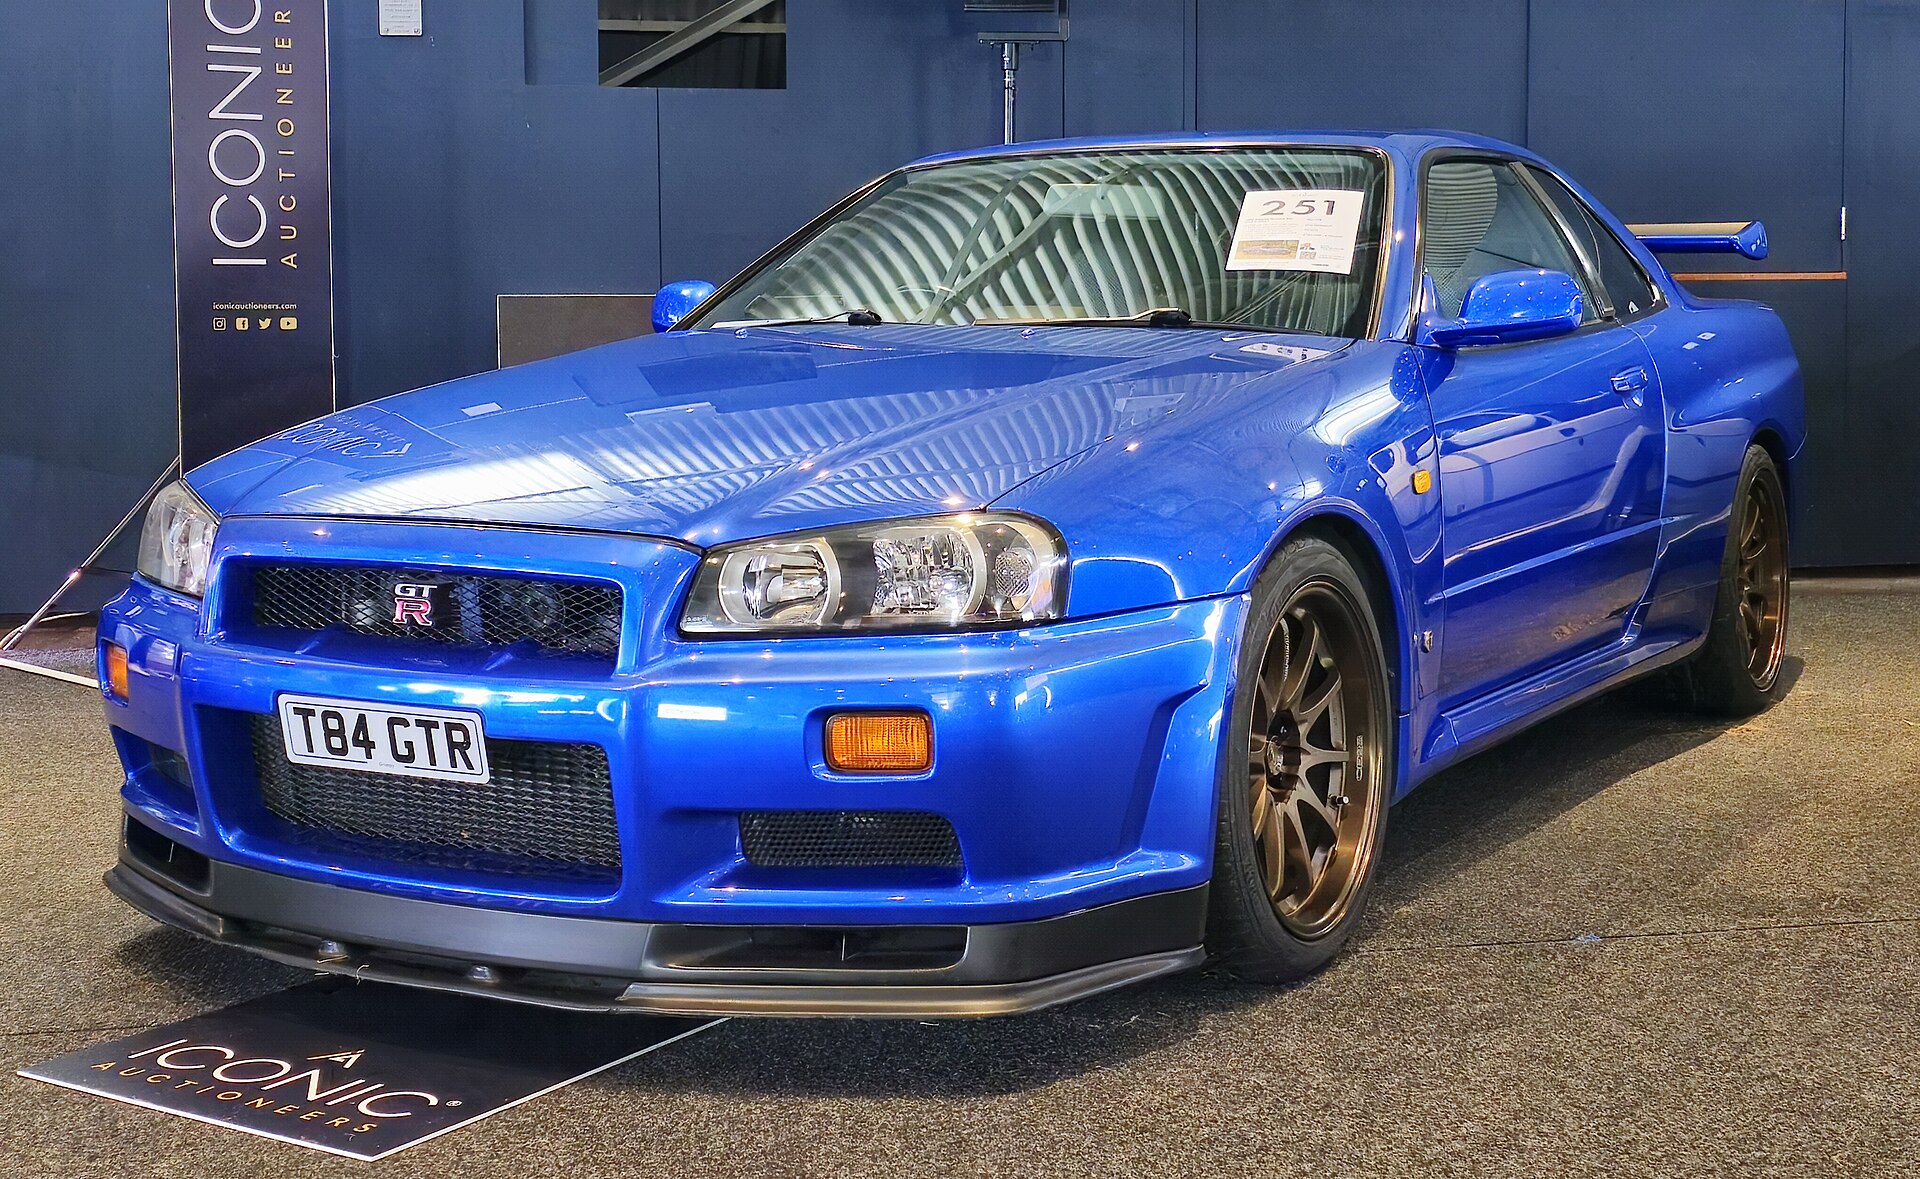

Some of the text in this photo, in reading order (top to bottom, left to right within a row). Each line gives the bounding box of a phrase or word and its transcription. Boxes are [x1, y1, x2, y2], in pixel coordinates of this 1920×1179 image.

[274, 10, 298, 268] AUCTIONEER
[1261, 199, 1335, 216] 251
[212, 302, 297, 310] iconicauctioneers.com
[392, 597, 432, 626] R
[394, 583, 438, 598] GT
[292, 706, 474, 770] T84 GTR
[90, 1061, 377, 1133] AUCTIONEERS
[127, 1038, 438, 1118] ICONIC
